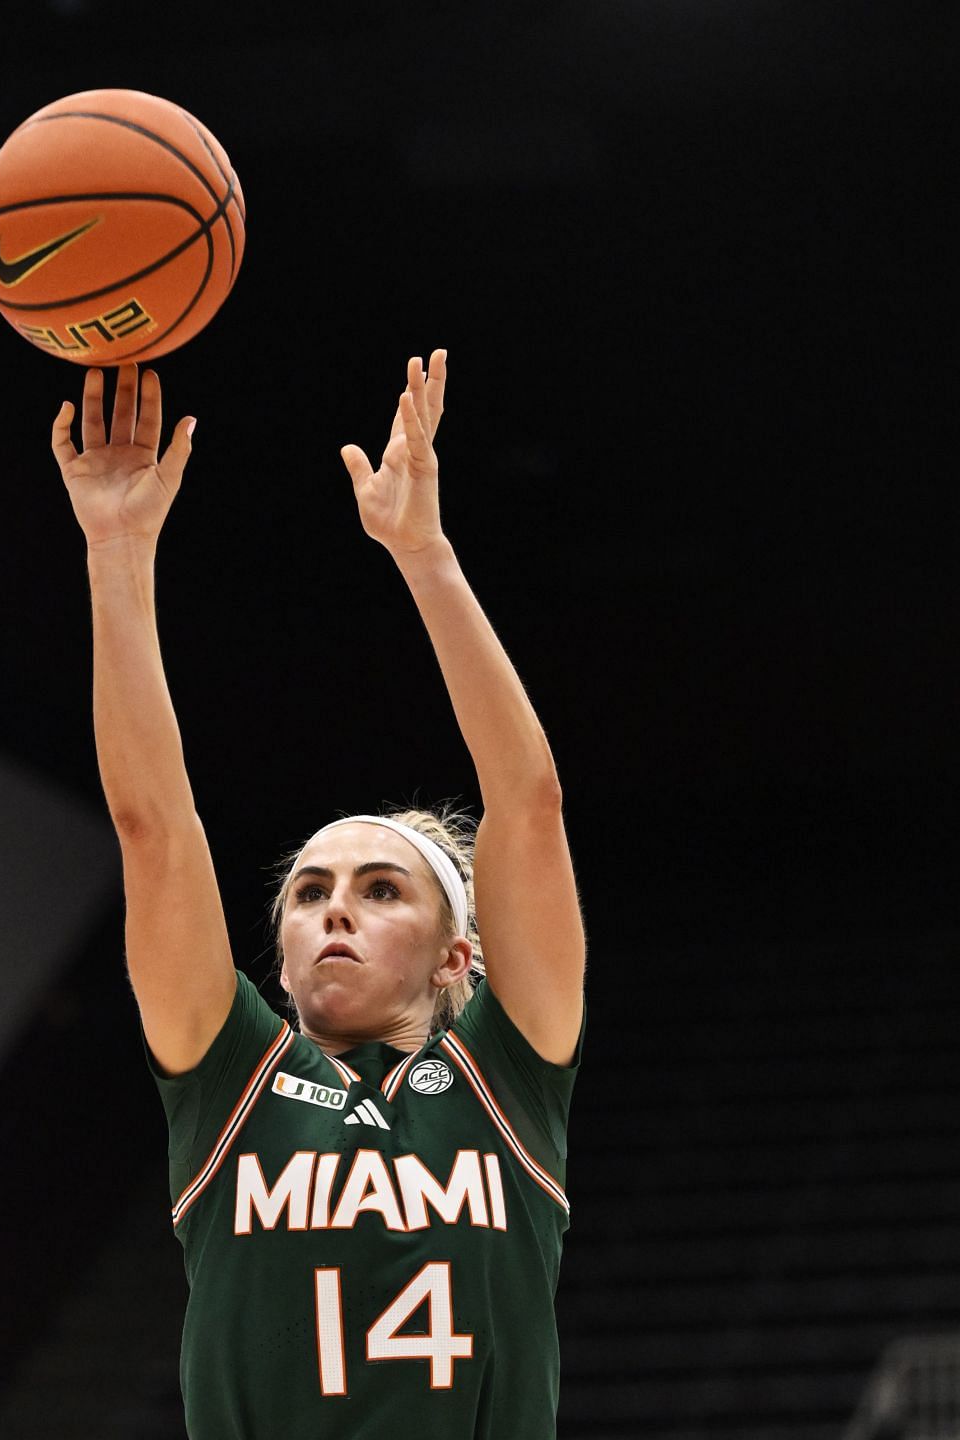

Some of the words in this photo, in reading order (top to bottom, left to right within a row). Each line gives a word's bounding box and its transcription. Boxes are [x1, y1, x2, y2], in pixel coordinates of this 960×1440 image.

[16, 297, 153, 354] ELITE
[309, 1085, 344, 1106] 100
[416, 1068, 449, 1083] ACC
[234, 1149, 508, 1236] MIAMI
[314, 1261, 474, 1397] 14
